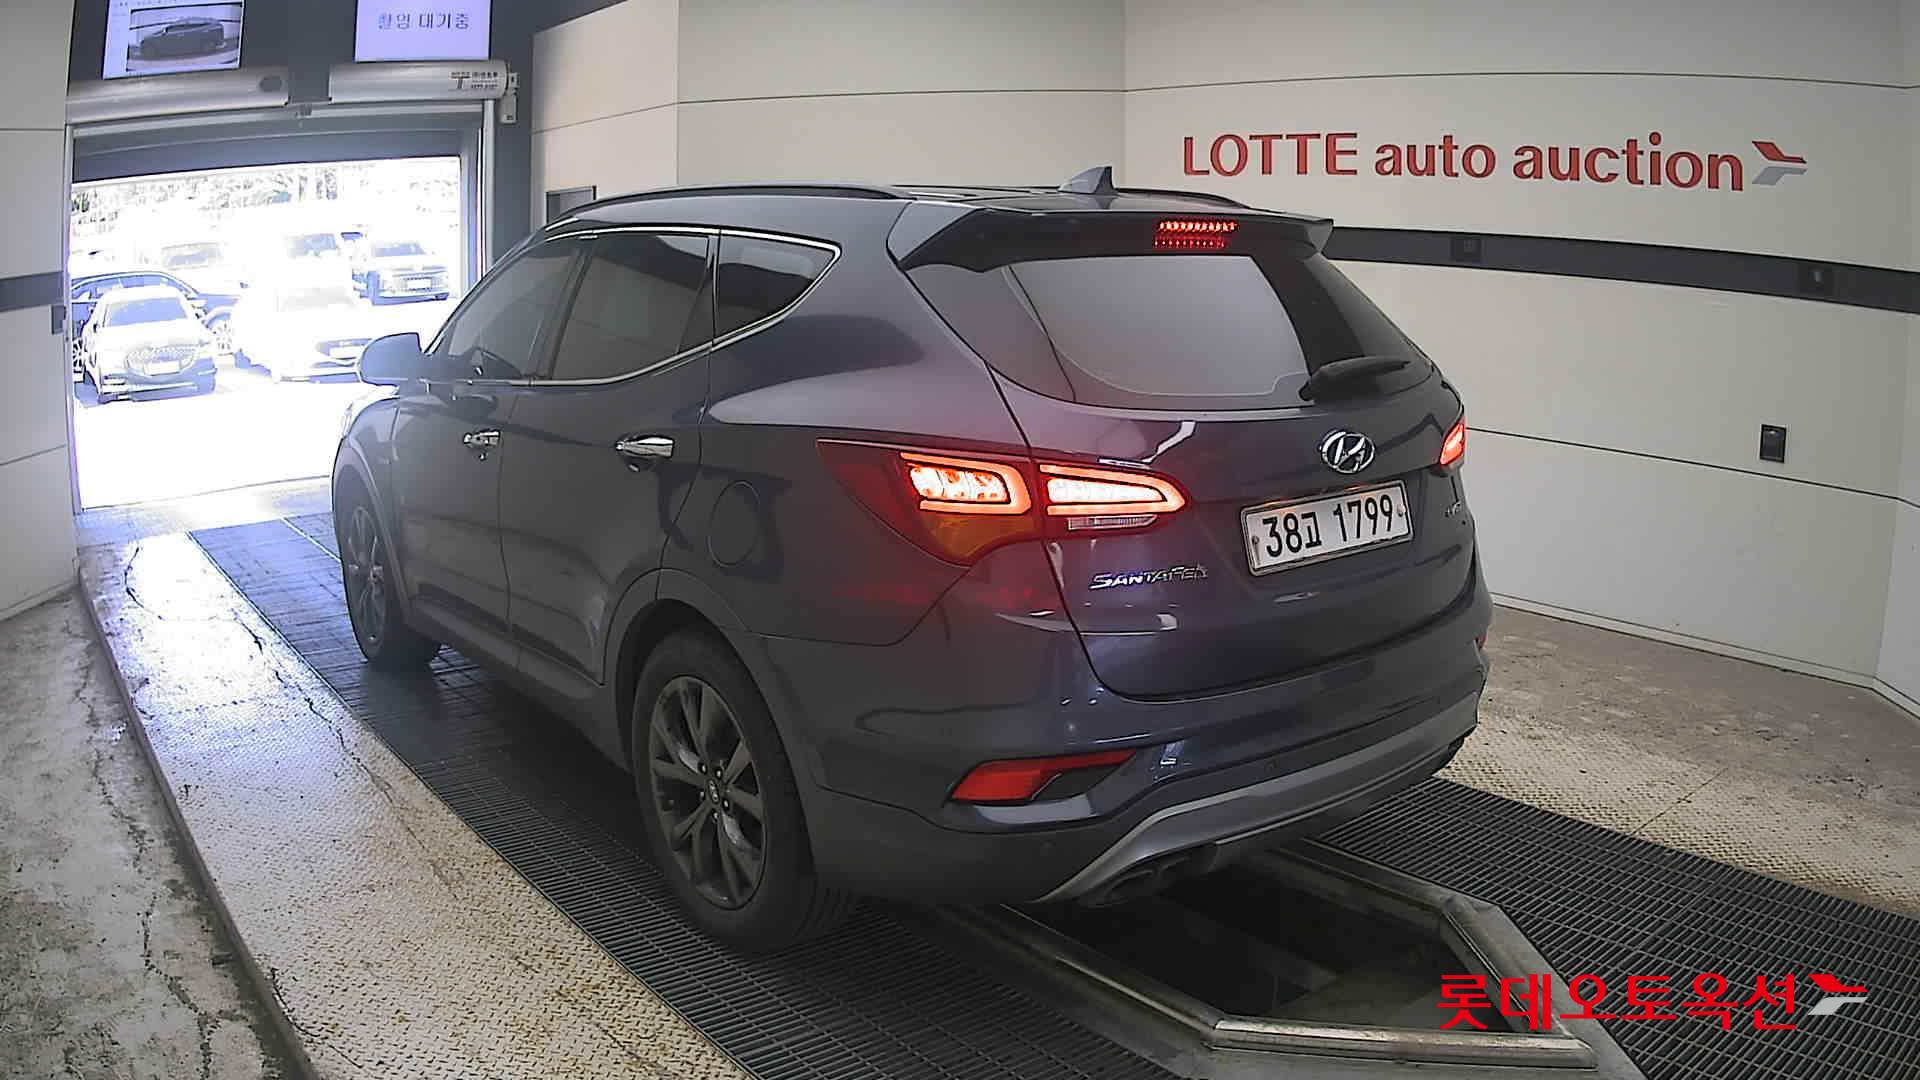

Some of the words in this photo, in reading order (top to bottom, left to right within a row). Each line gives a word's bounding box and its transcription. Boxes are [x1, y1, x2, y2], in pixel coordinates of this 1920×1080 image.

[1183, 132, 1358, 177] LOTTE
[1374, 134, 1496, 179] auto
[1513, 131, 1744, 192] auction
[1262, 510, 1323, 558] 38고
[1332, 494, 1394, 543] 1799
